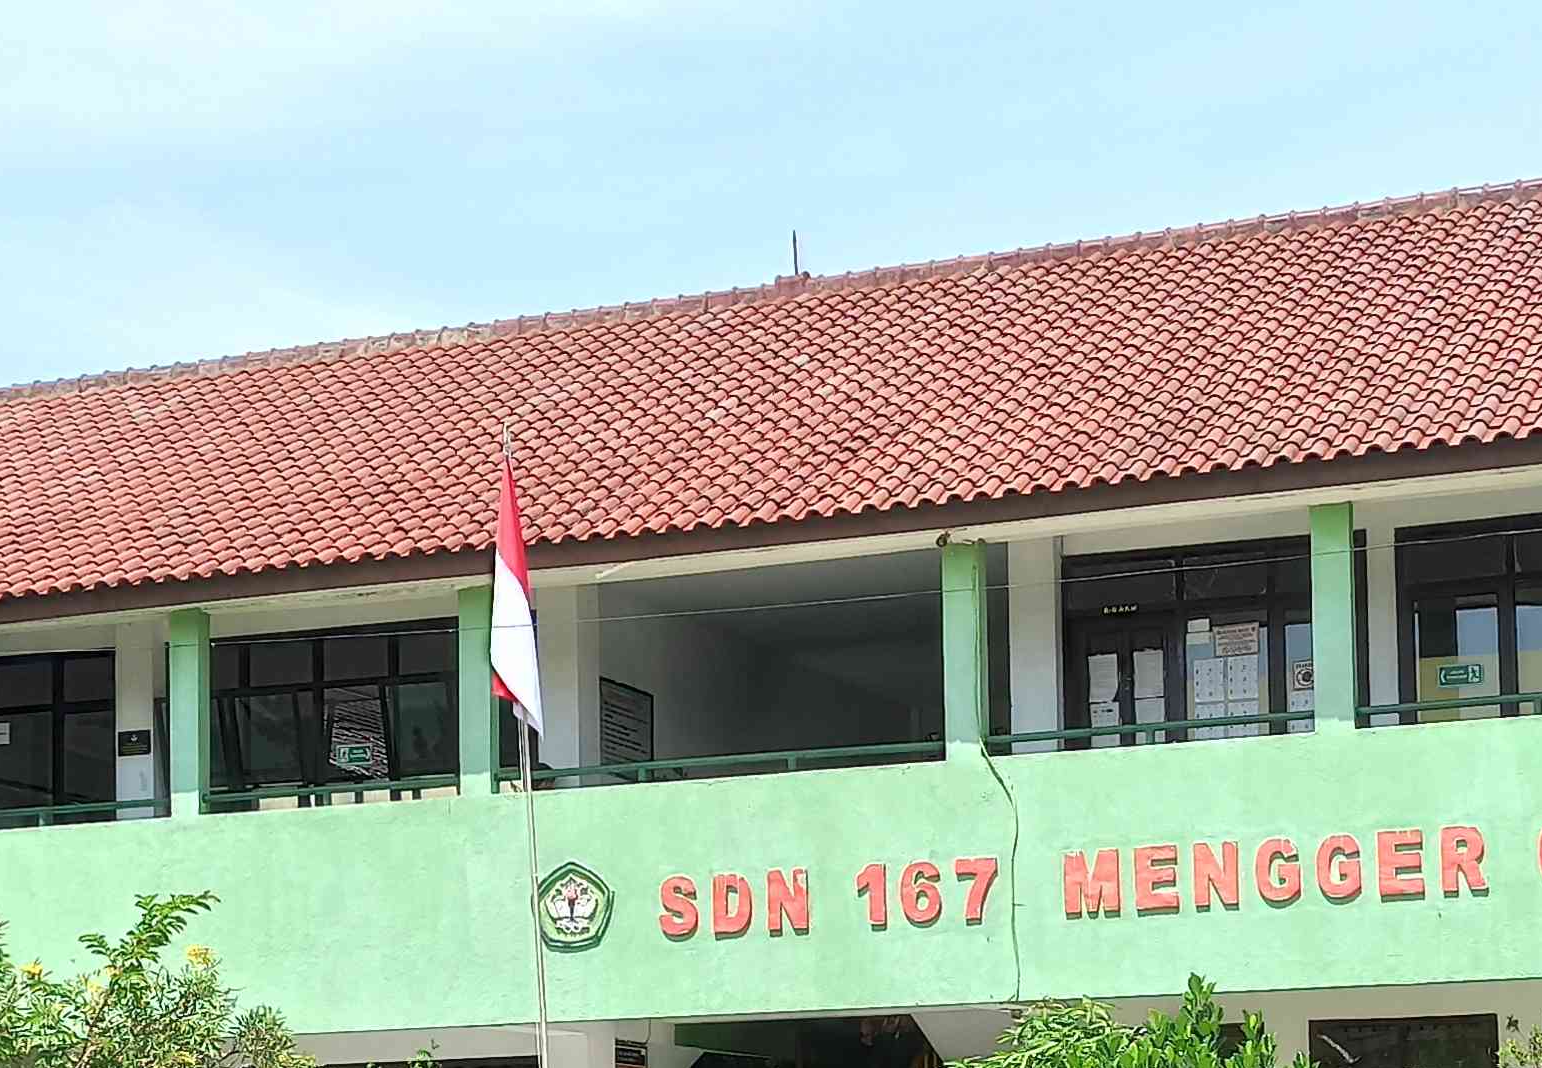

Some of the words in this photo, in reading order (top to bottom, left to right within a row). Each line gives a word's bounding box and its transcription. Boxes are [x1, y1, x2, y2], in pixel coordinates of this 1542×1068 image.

[659, 866, 811, 940] SDN
[852, 856, 999, 931] 167
[1062, 824, 1490, 919] MENGGER
